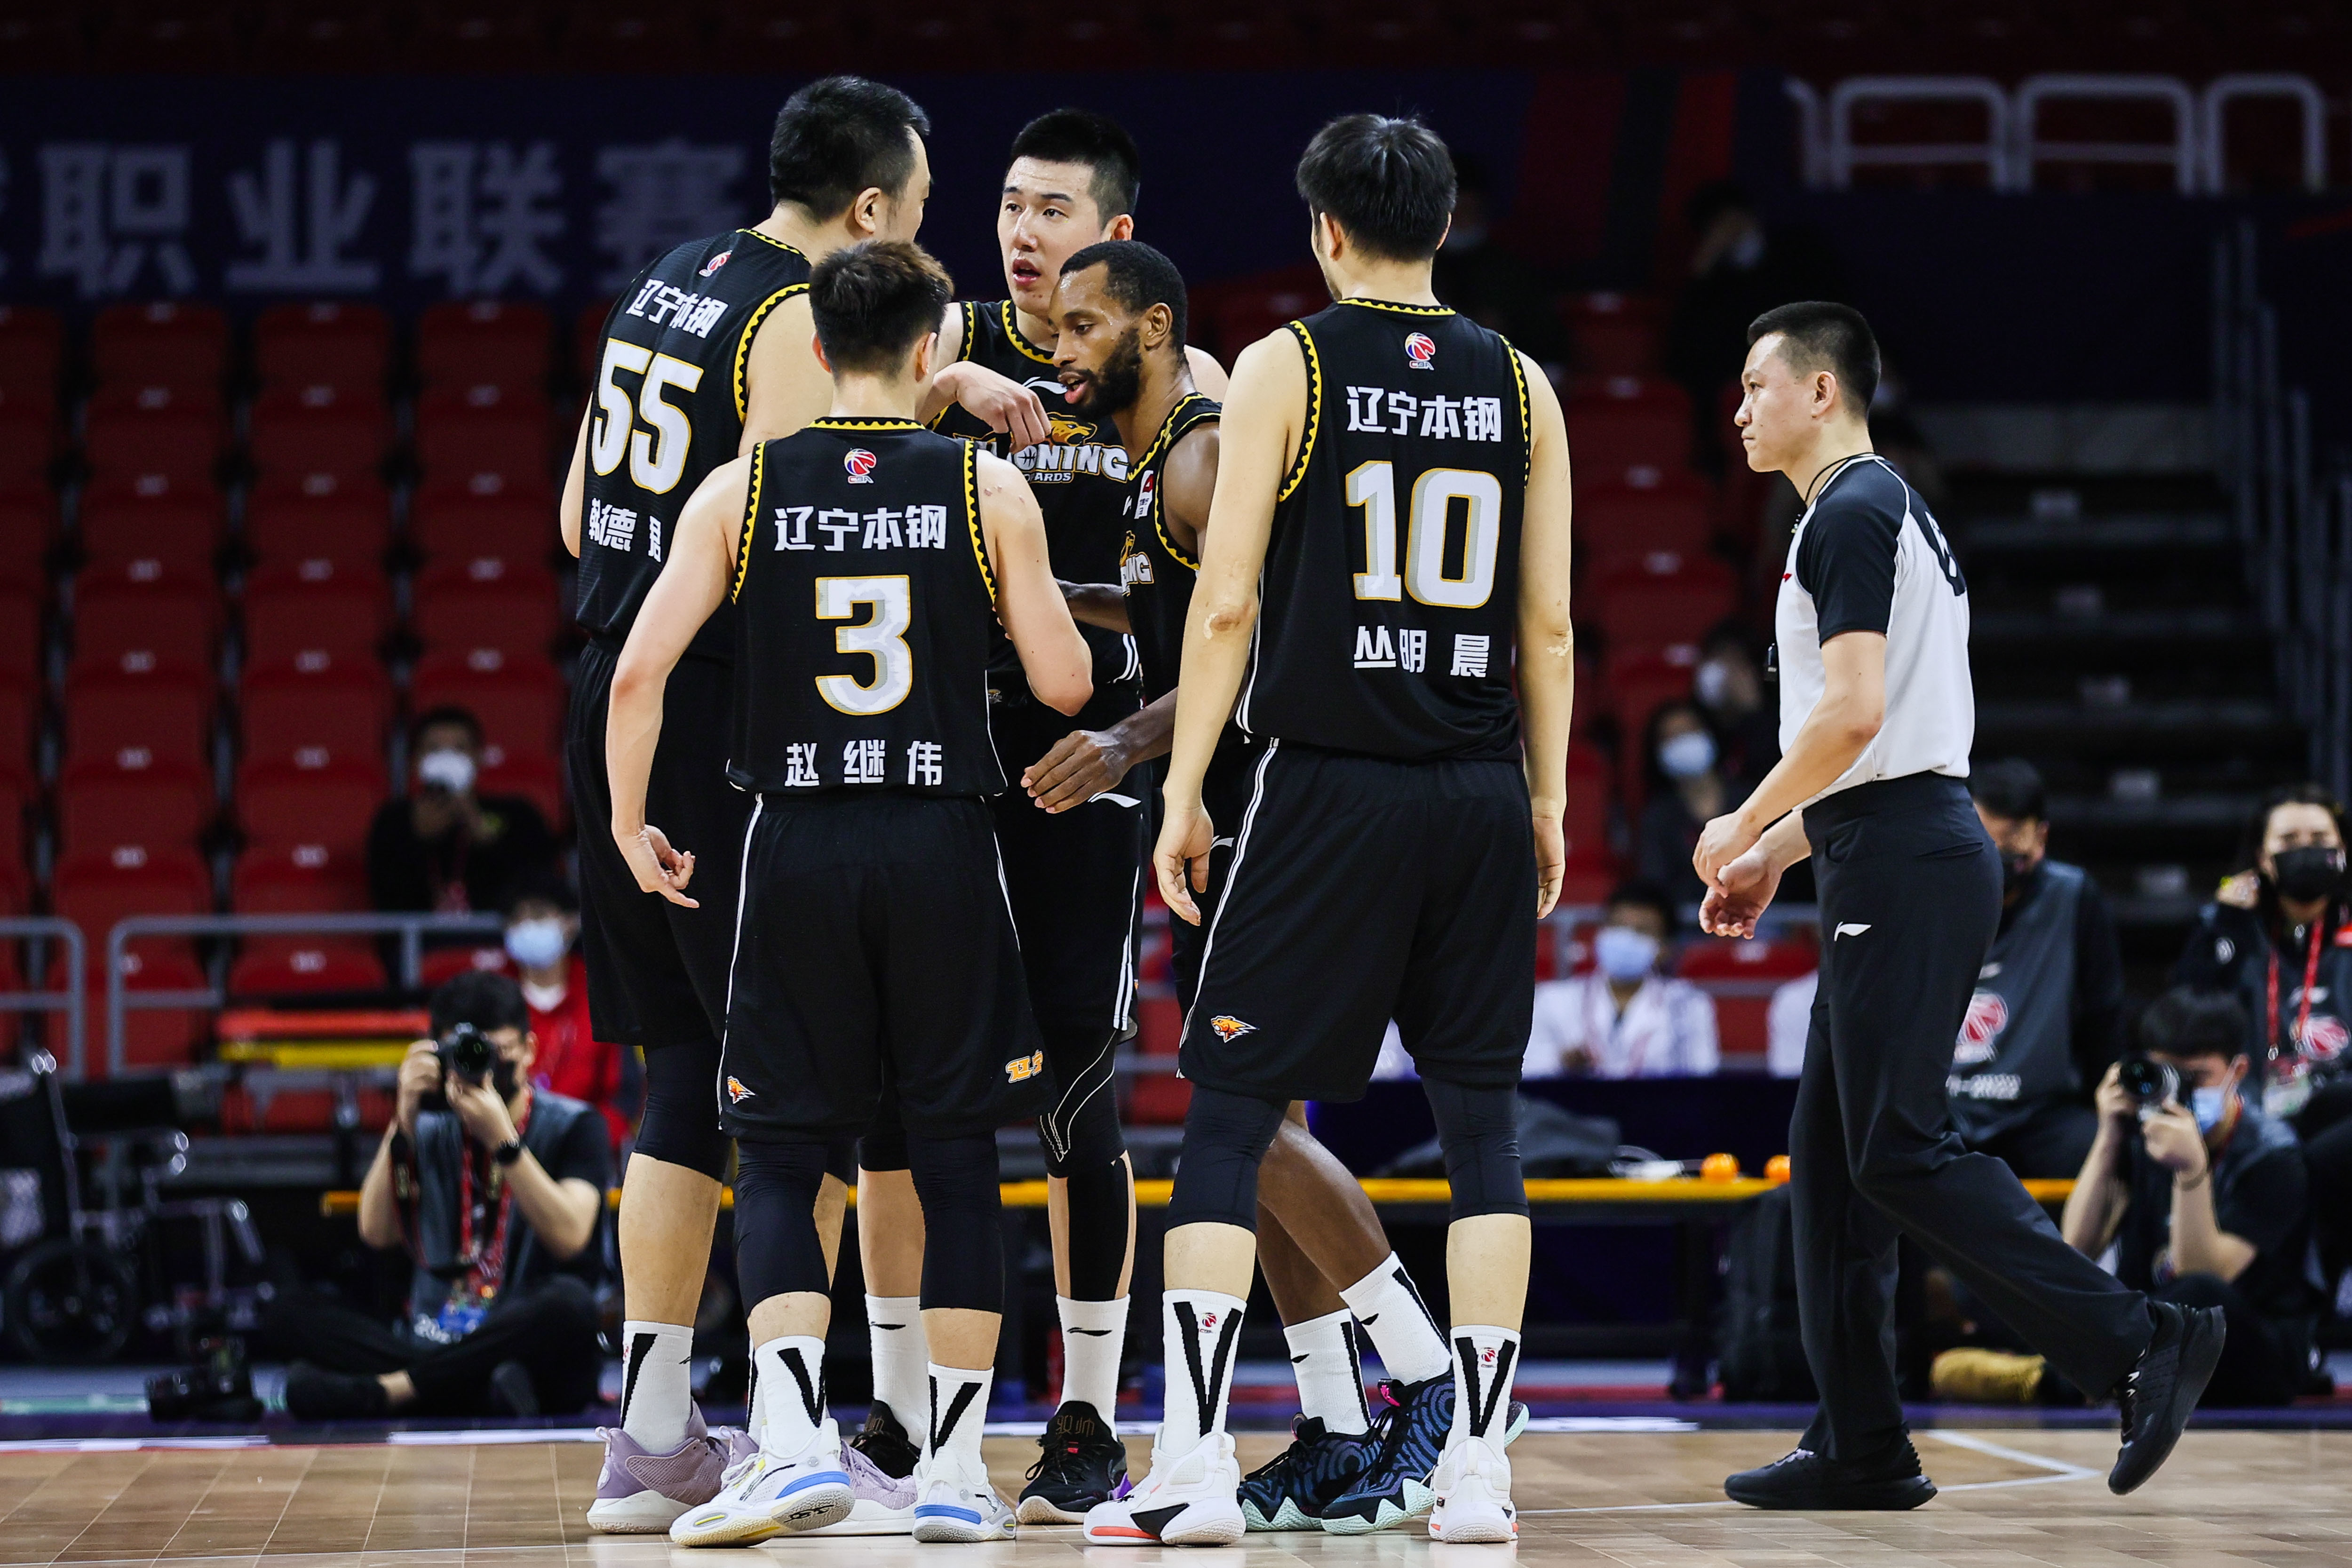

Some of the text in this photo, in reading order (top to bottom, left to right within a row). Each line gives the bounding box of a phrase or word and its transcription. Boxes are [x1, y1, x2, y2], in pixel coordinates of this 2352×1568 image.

[0, 137, 746, 297] 职业联赛
[626, 279, 728, 338] 辽宁本钢
[592, 337, 704, 495] 55
[1346, 386, 1502, 442] 辽宁本钢
[774, 505, 947, 551] 辽宁本钢
[1346, 461, 1502, 609] 10
[815, 575, 913, 716] 3
[1354, 625, 1490, 677] 丛明晨
[785, 740, 942, 787] 赵继伟
